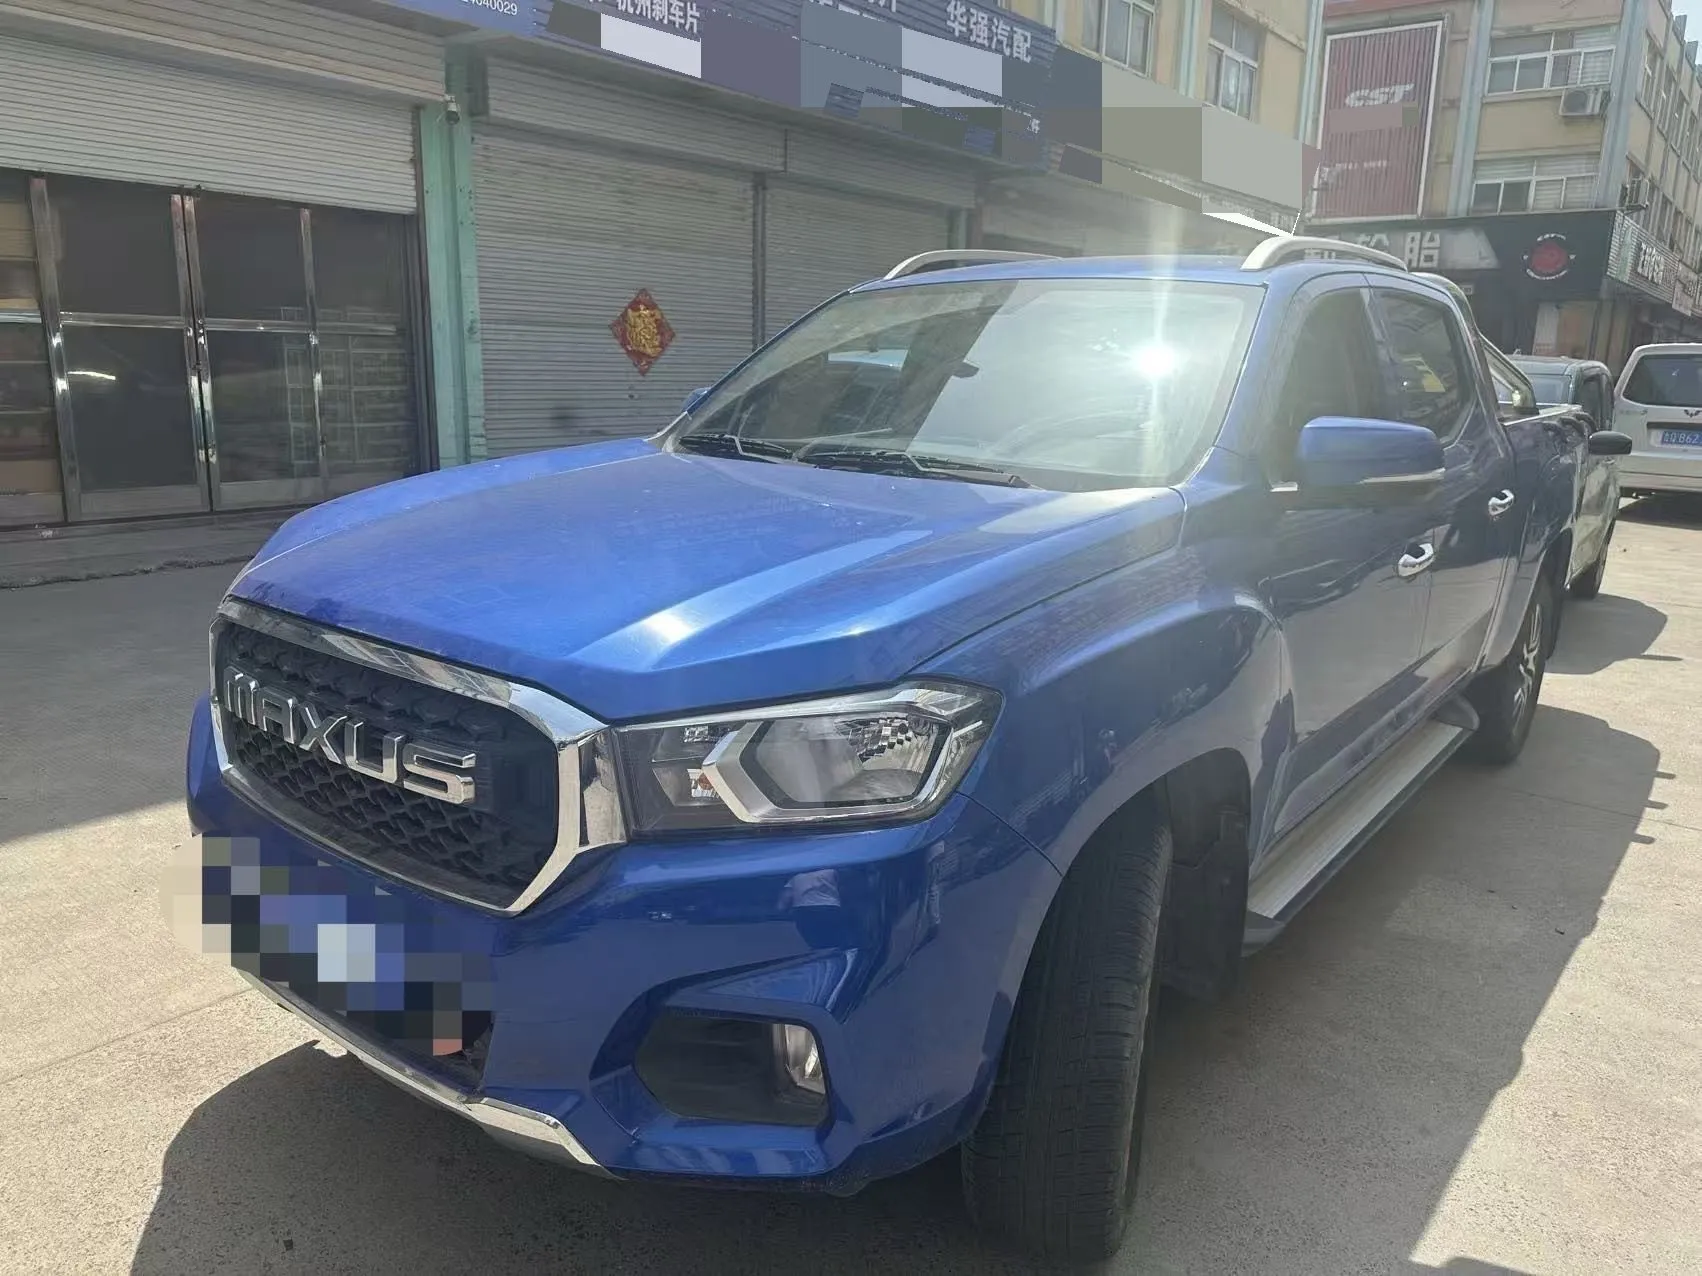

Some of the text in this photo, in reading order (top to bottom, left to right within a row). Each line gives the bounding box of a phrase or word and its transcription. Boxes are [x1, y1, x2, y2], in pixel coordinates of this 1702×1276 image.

[946, 0, 1032, 63] 华强汽配
[223, 665, 477, 804] MAXUS
